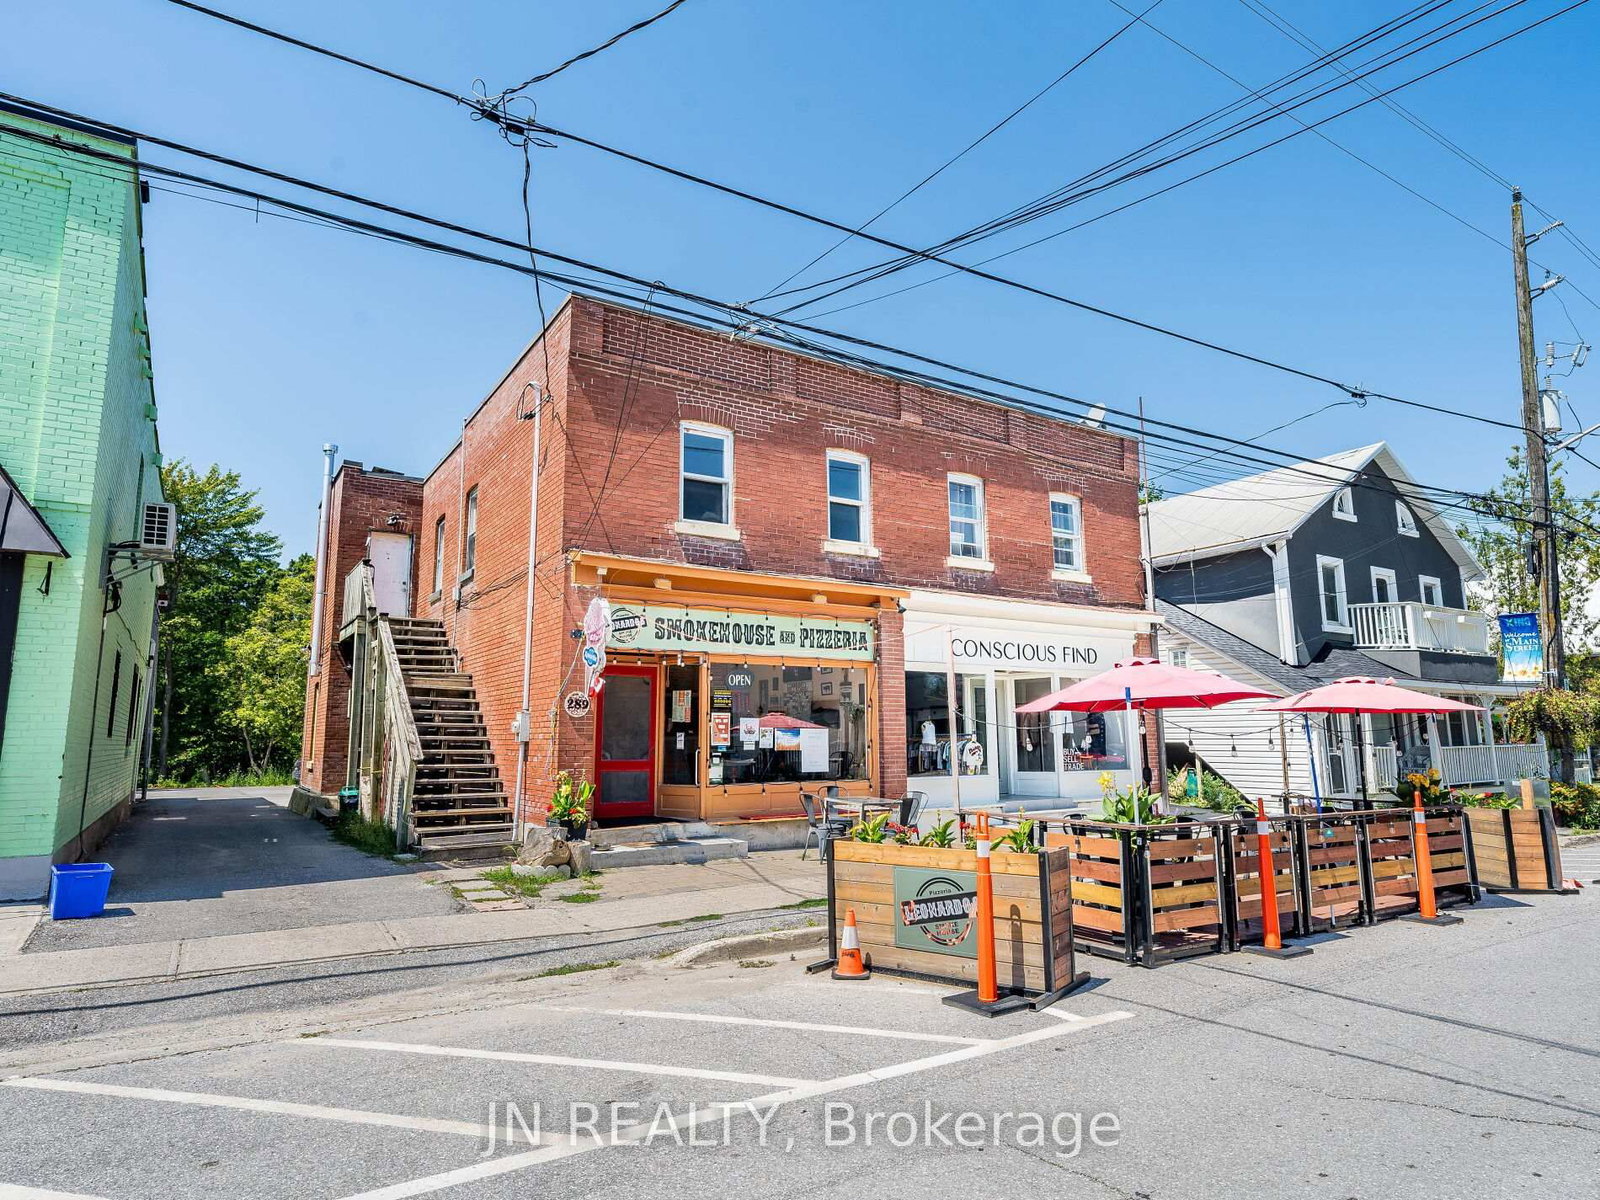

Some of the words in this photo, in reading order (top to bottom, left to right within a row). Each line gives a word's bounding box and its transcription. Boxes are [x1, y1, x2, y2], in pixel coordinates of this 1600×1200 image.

[654, 617, 776, 646] SMOKEHOUSE
[779, 630, 796, 644] AND
[799, 627, 868, 651] PIZZERIA
[1512, 637, 1539, 645] MAIN
[951, 638, 1057, 663] CONSCIOUS
[1063, 646, 1098, 664] FIND
[728, 674, 751, 686] OPEN
[567, 698, 589, 710] 289
[1063, 748, 1076, 756] BUY
[1063, 755, 1078, 763] SELL
[1064, 762, 1085, 771] TRADE
